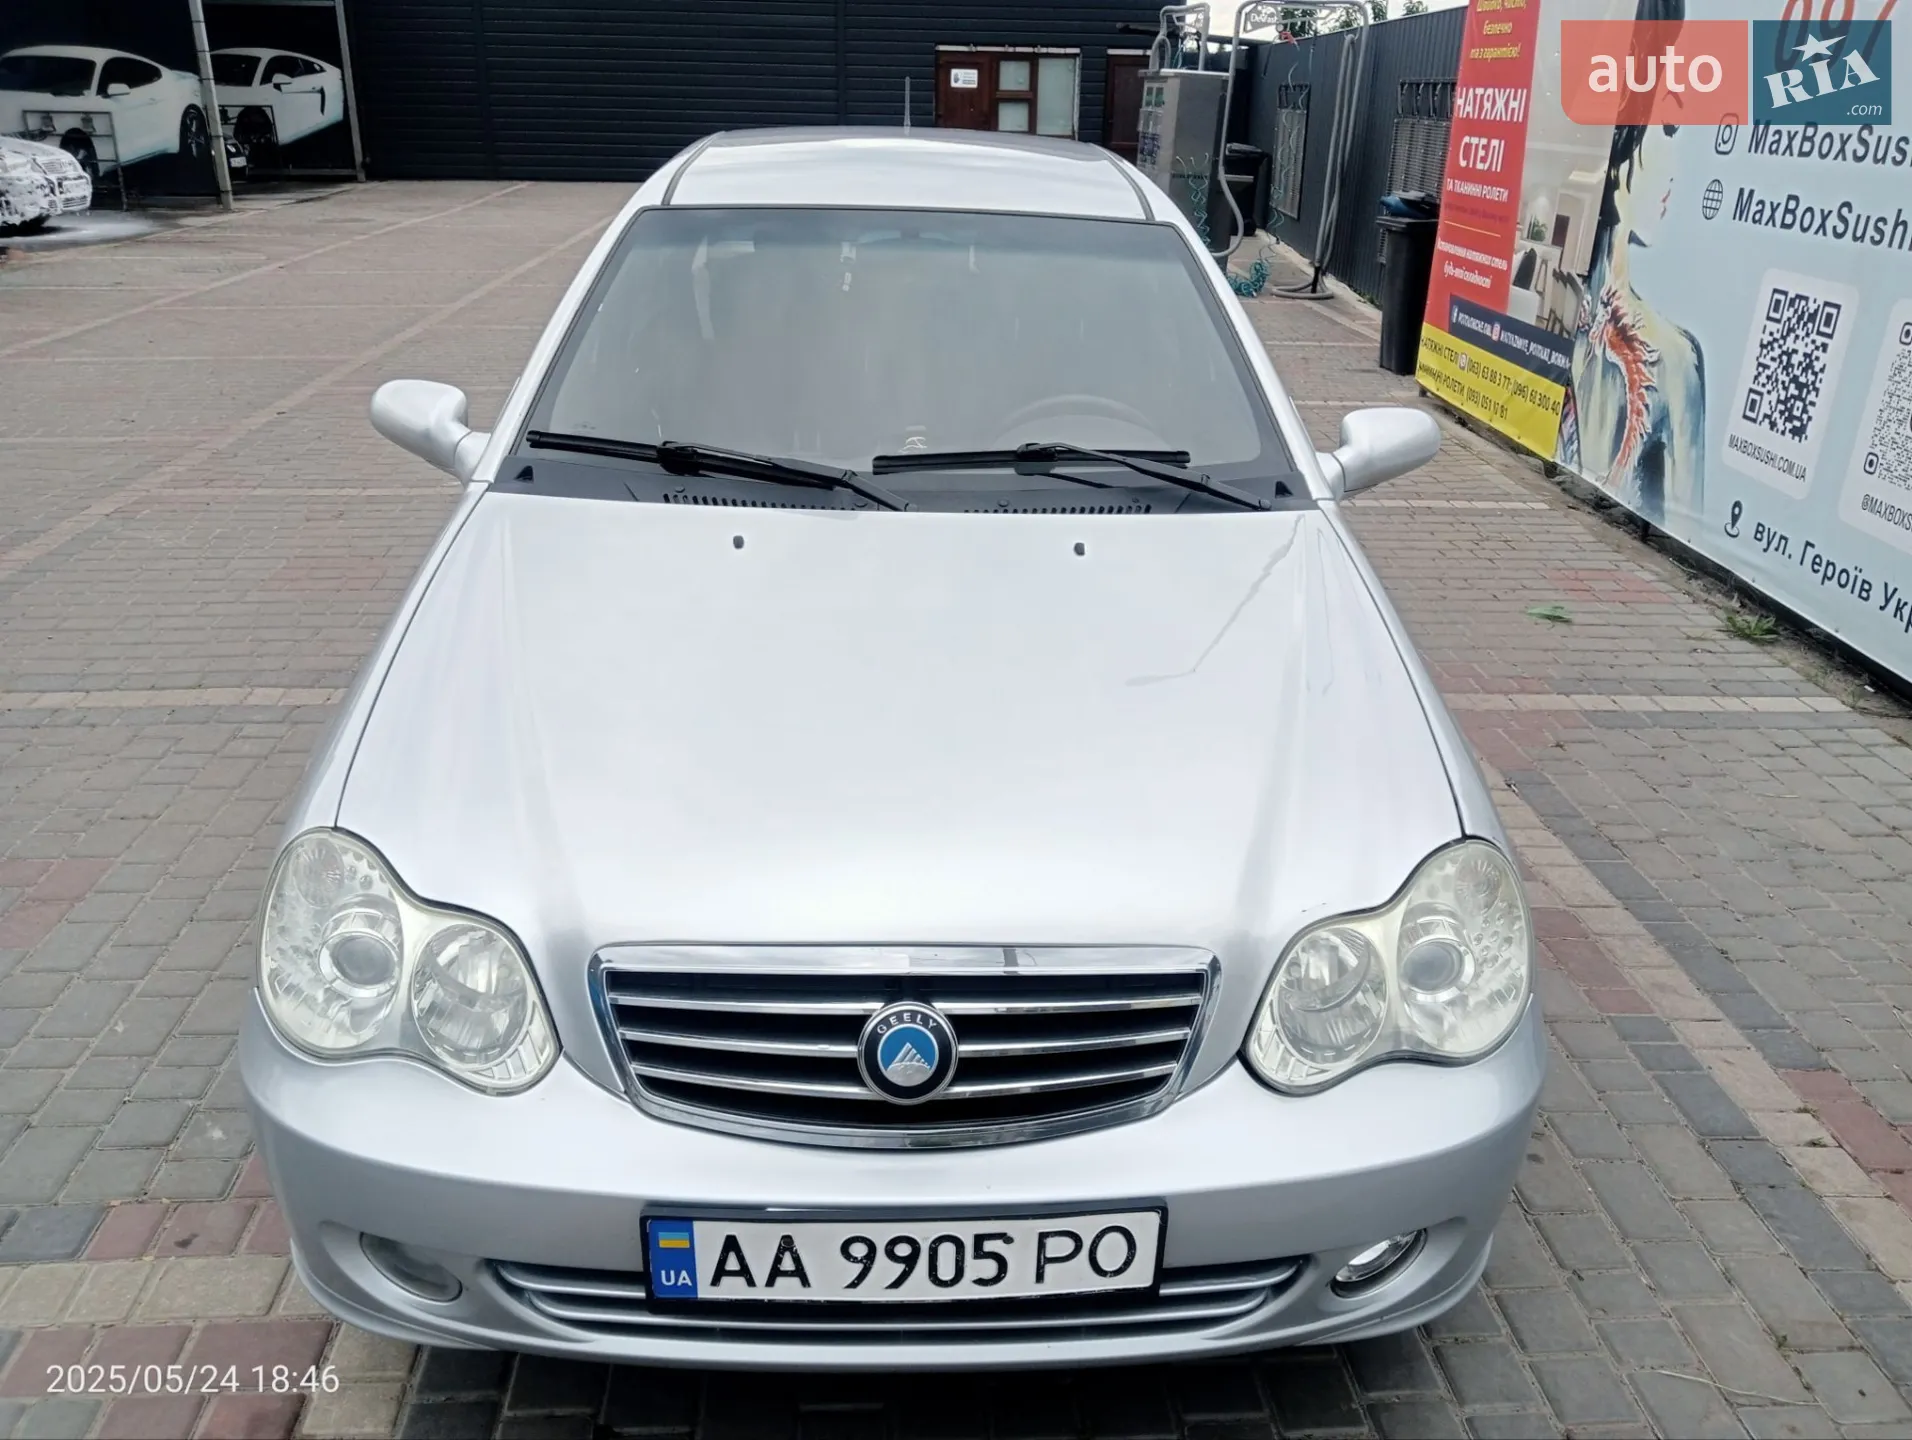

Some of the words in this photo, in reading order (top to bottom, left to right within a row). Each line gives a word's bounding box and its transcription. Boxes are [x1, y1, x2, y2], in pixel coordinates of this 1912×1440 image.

[1455, 86, 1527, 122] НАТЯЖНІ
[1459, 135, 1505, 173] СТЕЛІ
[1748, 119, 1912, 167] MaxBoxSus
[1446, 178, 1454, 191] ТА
[1482, 184, 1509, 202] РОЛЕТИ
[1732, 187, 1912, 252] MaxBoxSush
[1728, 433, 1807, 482] MAXBOXSUSHI.COM.UA
[1861, 493, 1912, 533] @MAXBOXS
[1753, 522, 1793, 559] вул.
[1799, 540, 1873, 603] Героїв
[877, 1012, 937, 1034] GEELY
[709, 1233, 812, 1289] AA
[839, 1232, 1010, 1290] 9905
[1034, 1225, 1138, 1285] PO
[660, 1270, 693, 1288] UA
